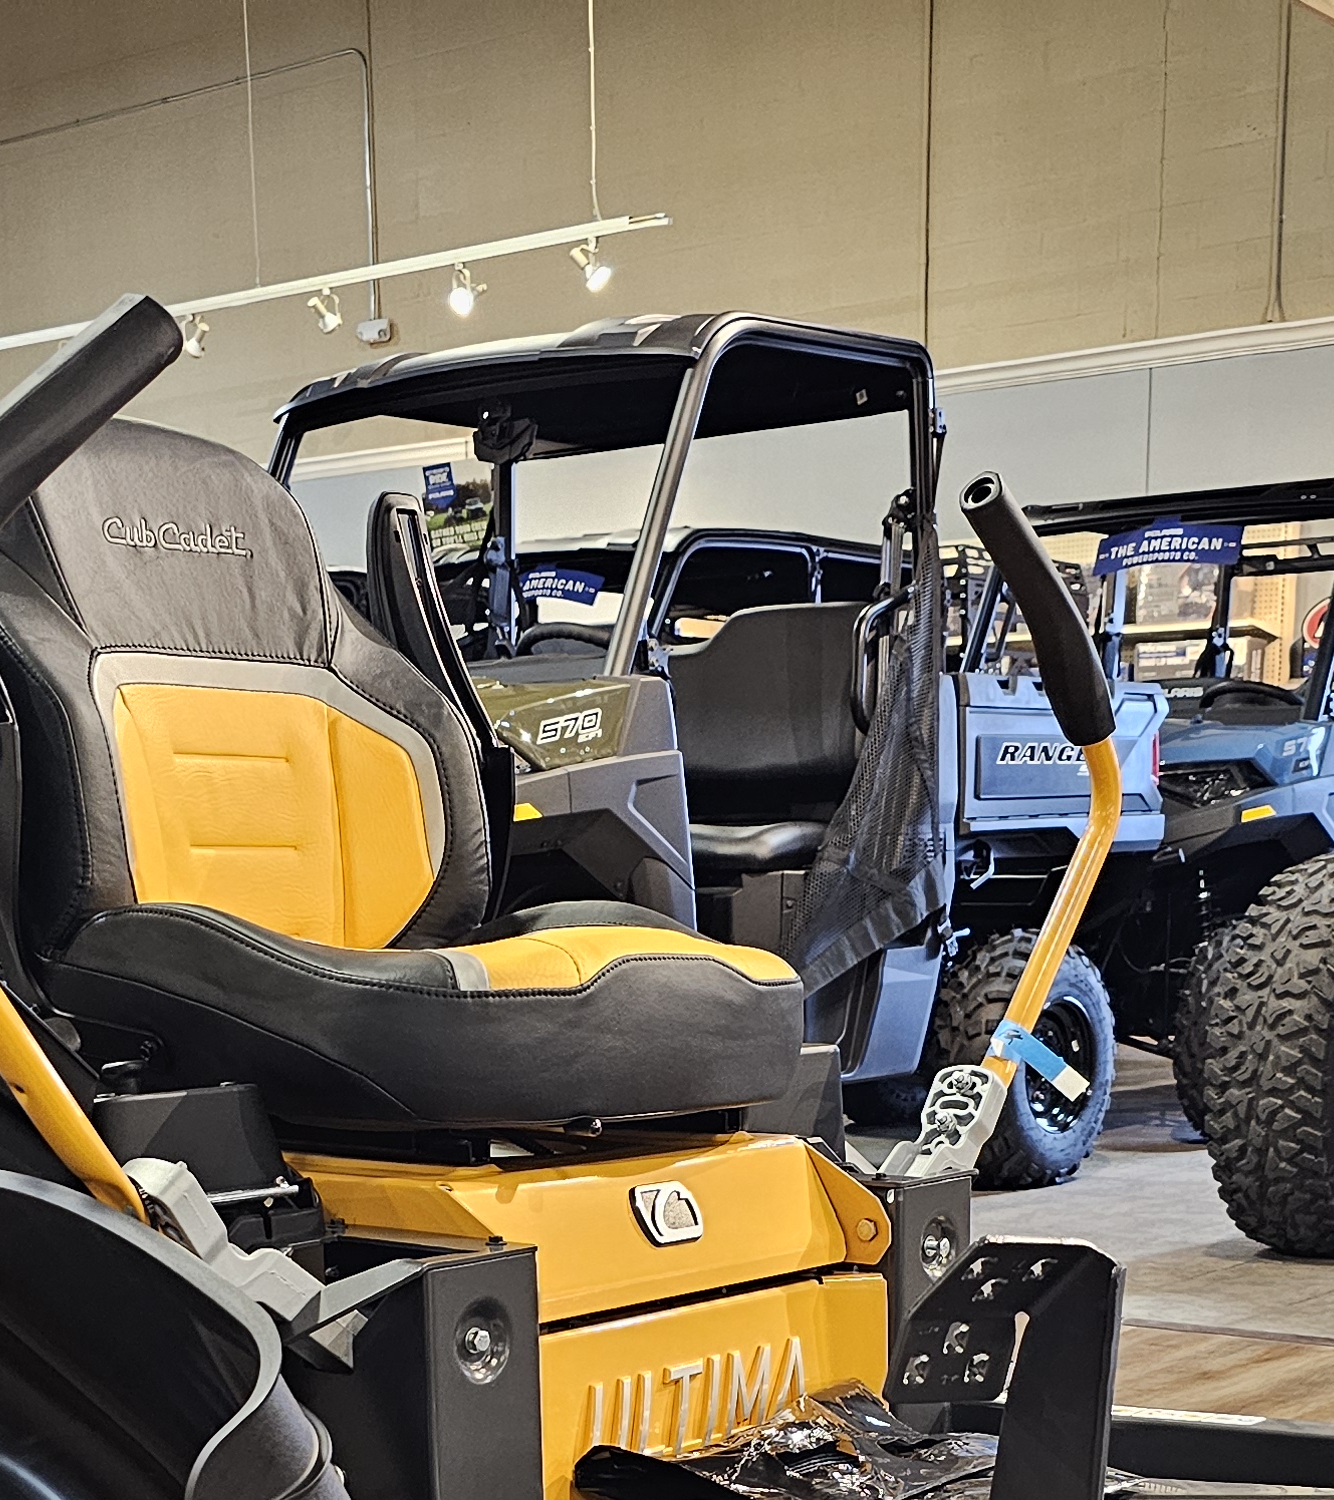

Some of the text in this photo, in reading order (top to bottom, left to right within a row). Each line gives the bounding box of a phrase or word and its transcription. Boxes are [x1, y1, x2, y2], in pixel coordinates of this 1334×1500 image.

[102, 516, 246, 557] Cub Cadet
[1110, 537, 1223, 560] THE AMERICAN
[522, 578, 585, 594] AMERICAN
[1163, 686, 1203, 698] LARIS
[536, 707, 602, 745] 570
[589, 1336, 806, 1459] ULTIMA
